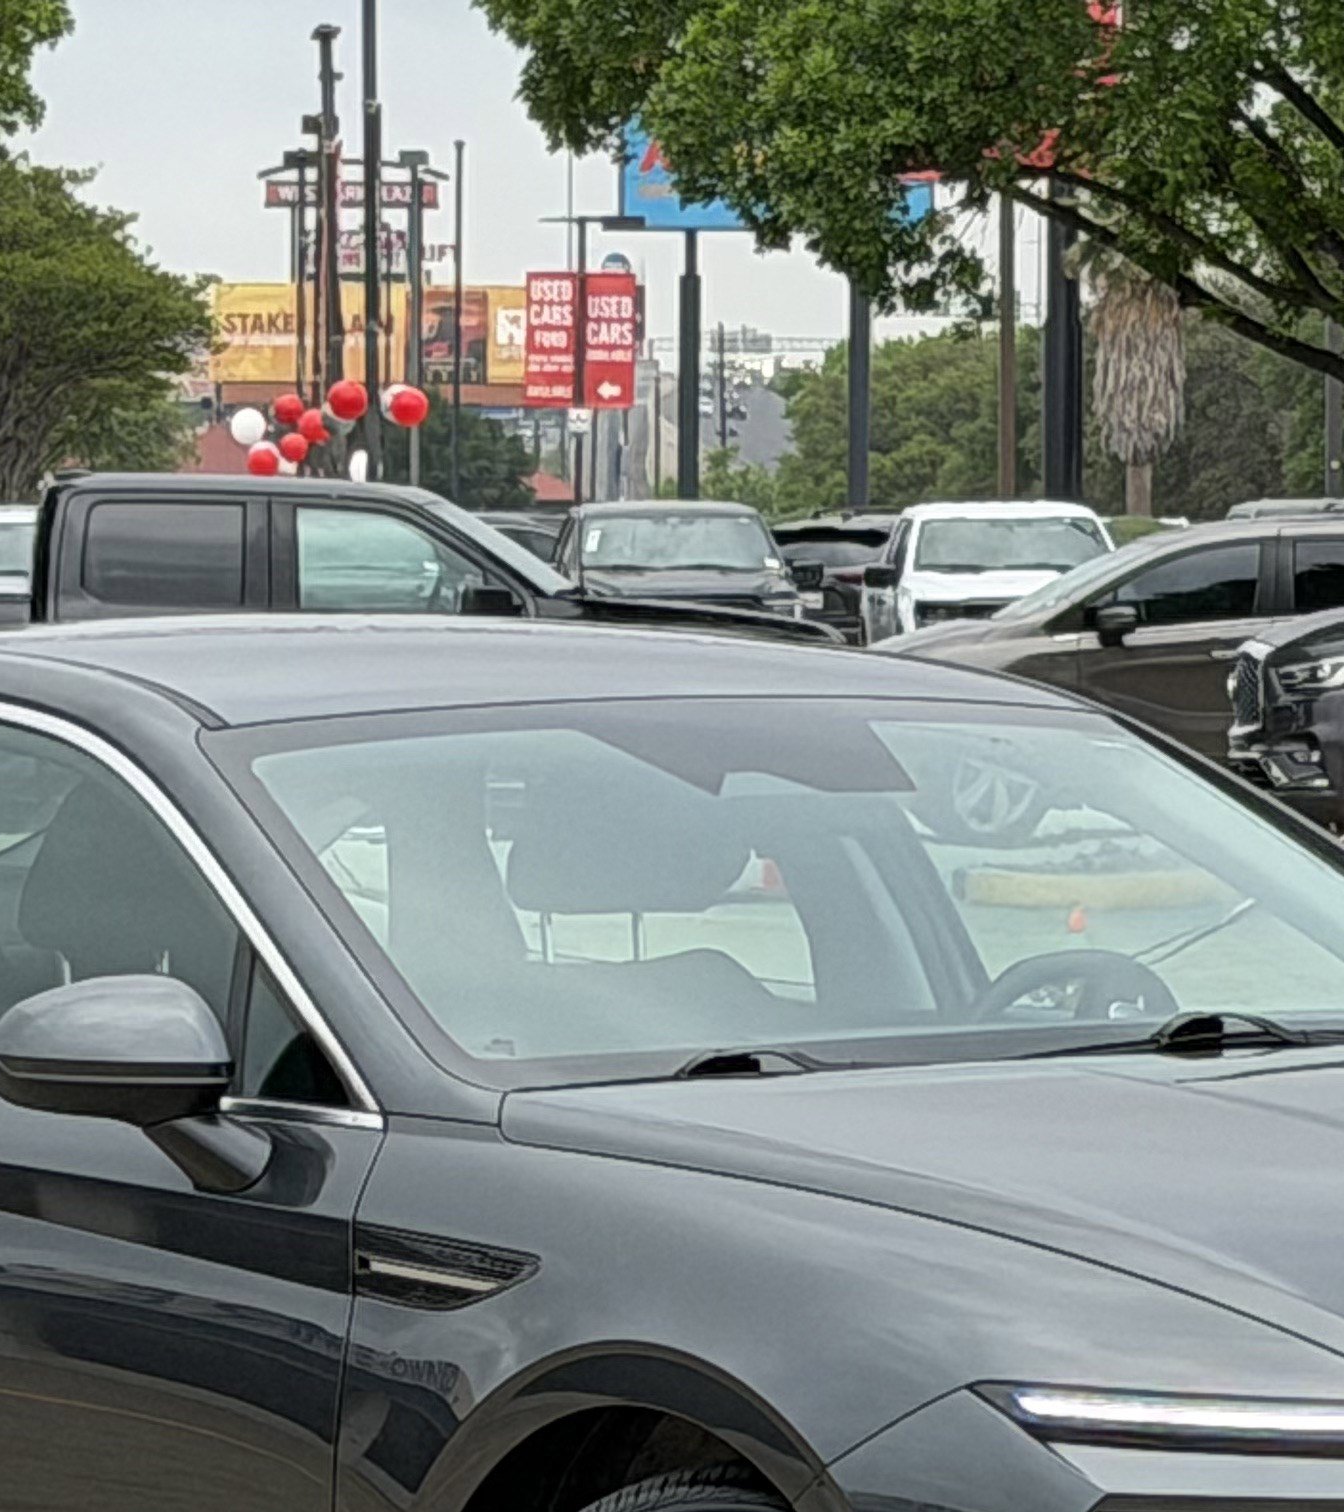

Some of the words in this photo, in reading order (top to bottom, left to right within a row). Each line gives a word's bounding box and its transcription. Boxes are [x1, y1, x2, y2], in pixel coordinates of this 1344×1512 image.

[530, 279, 573, 301] USED
[587, 296, 633, 318] USED
[222, 313, 295, 334] STAKE
[586, 322, 633, 345] CARS
